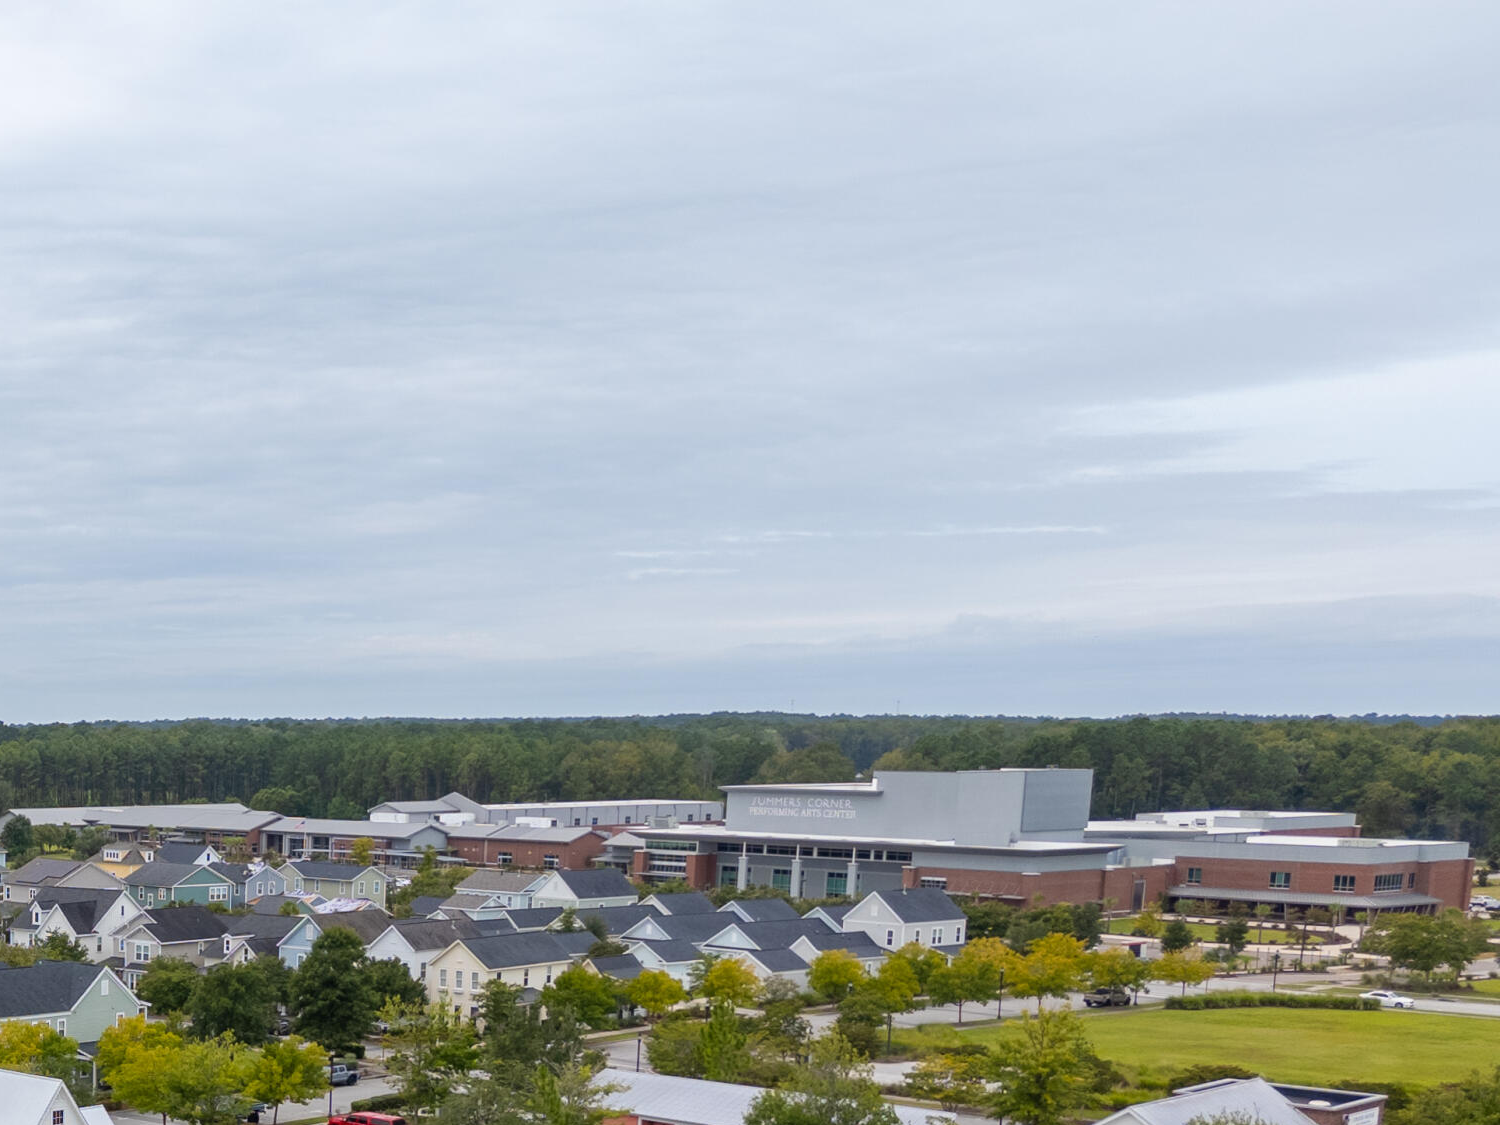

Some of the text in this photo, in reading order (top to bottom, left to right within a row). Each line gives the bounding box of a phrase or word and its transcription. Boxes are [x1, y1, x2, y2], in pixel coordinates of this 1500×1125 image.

[751, 796, 852, 808] SUMMERS CORNER
[749, 807, 856, 819] PERFORMING ARTS CENTER
